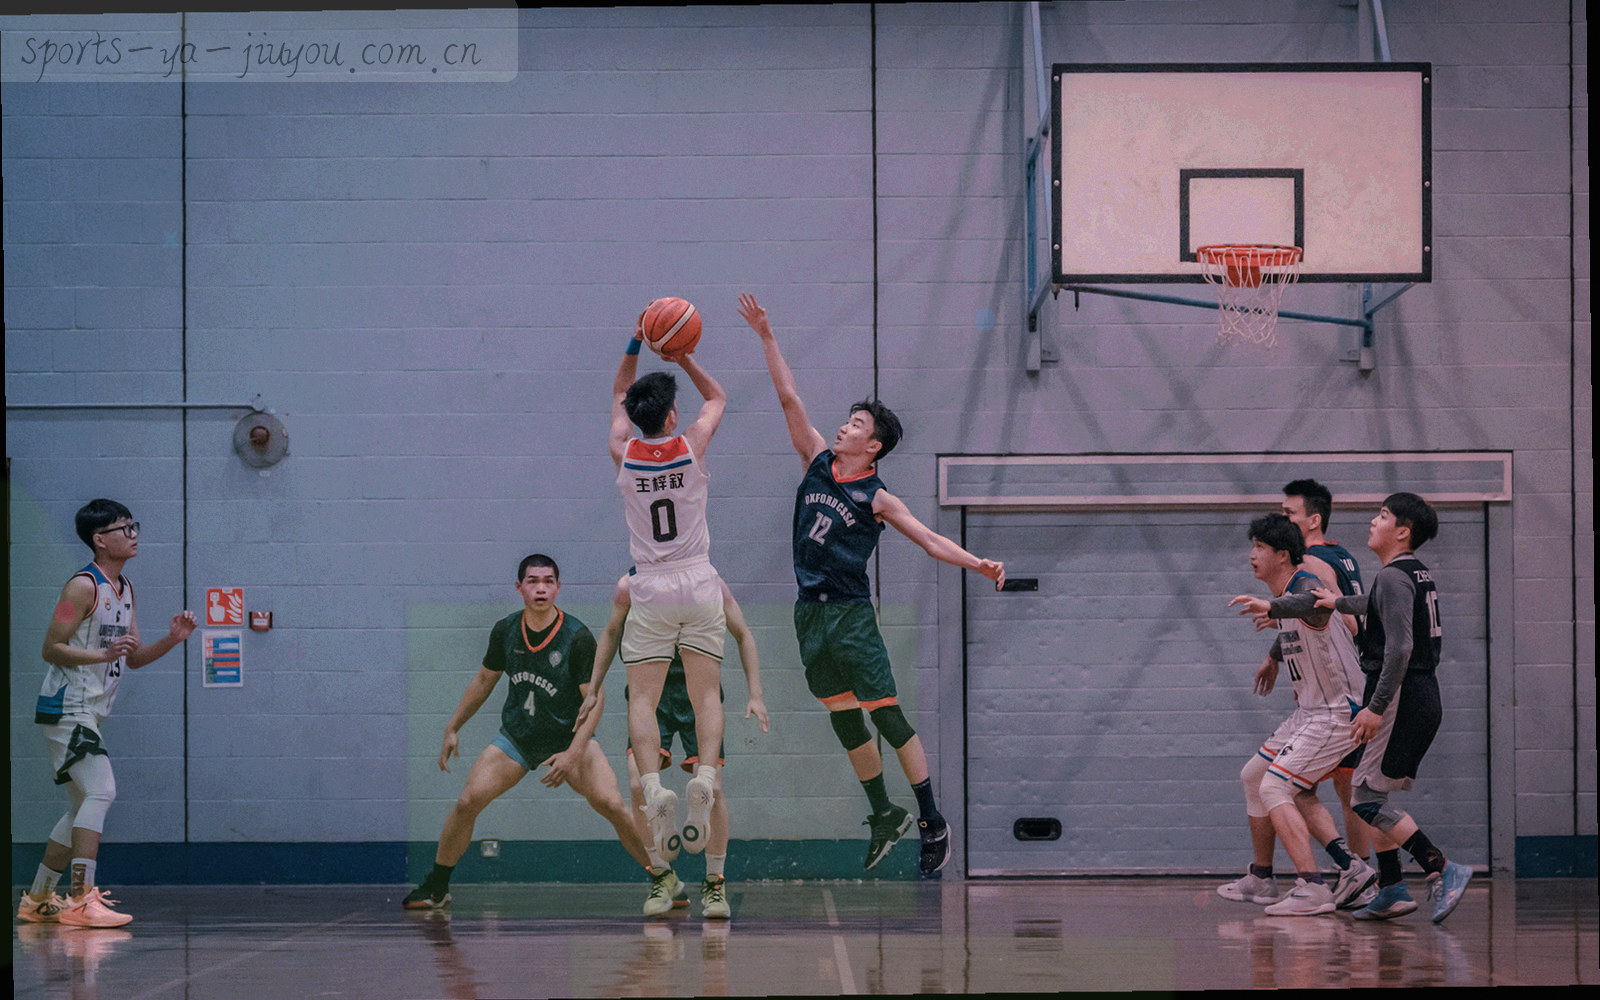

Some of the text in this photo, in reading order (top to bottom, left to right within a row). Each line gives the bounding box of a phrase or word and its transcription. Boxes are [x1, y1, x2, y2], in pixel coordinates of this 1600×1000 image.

[650, 498, 678, 543] 0
[808, 511, 833, 545] 12
[1287, 658, 1302, 681] 11
[523, 690, 536, 716] 4
